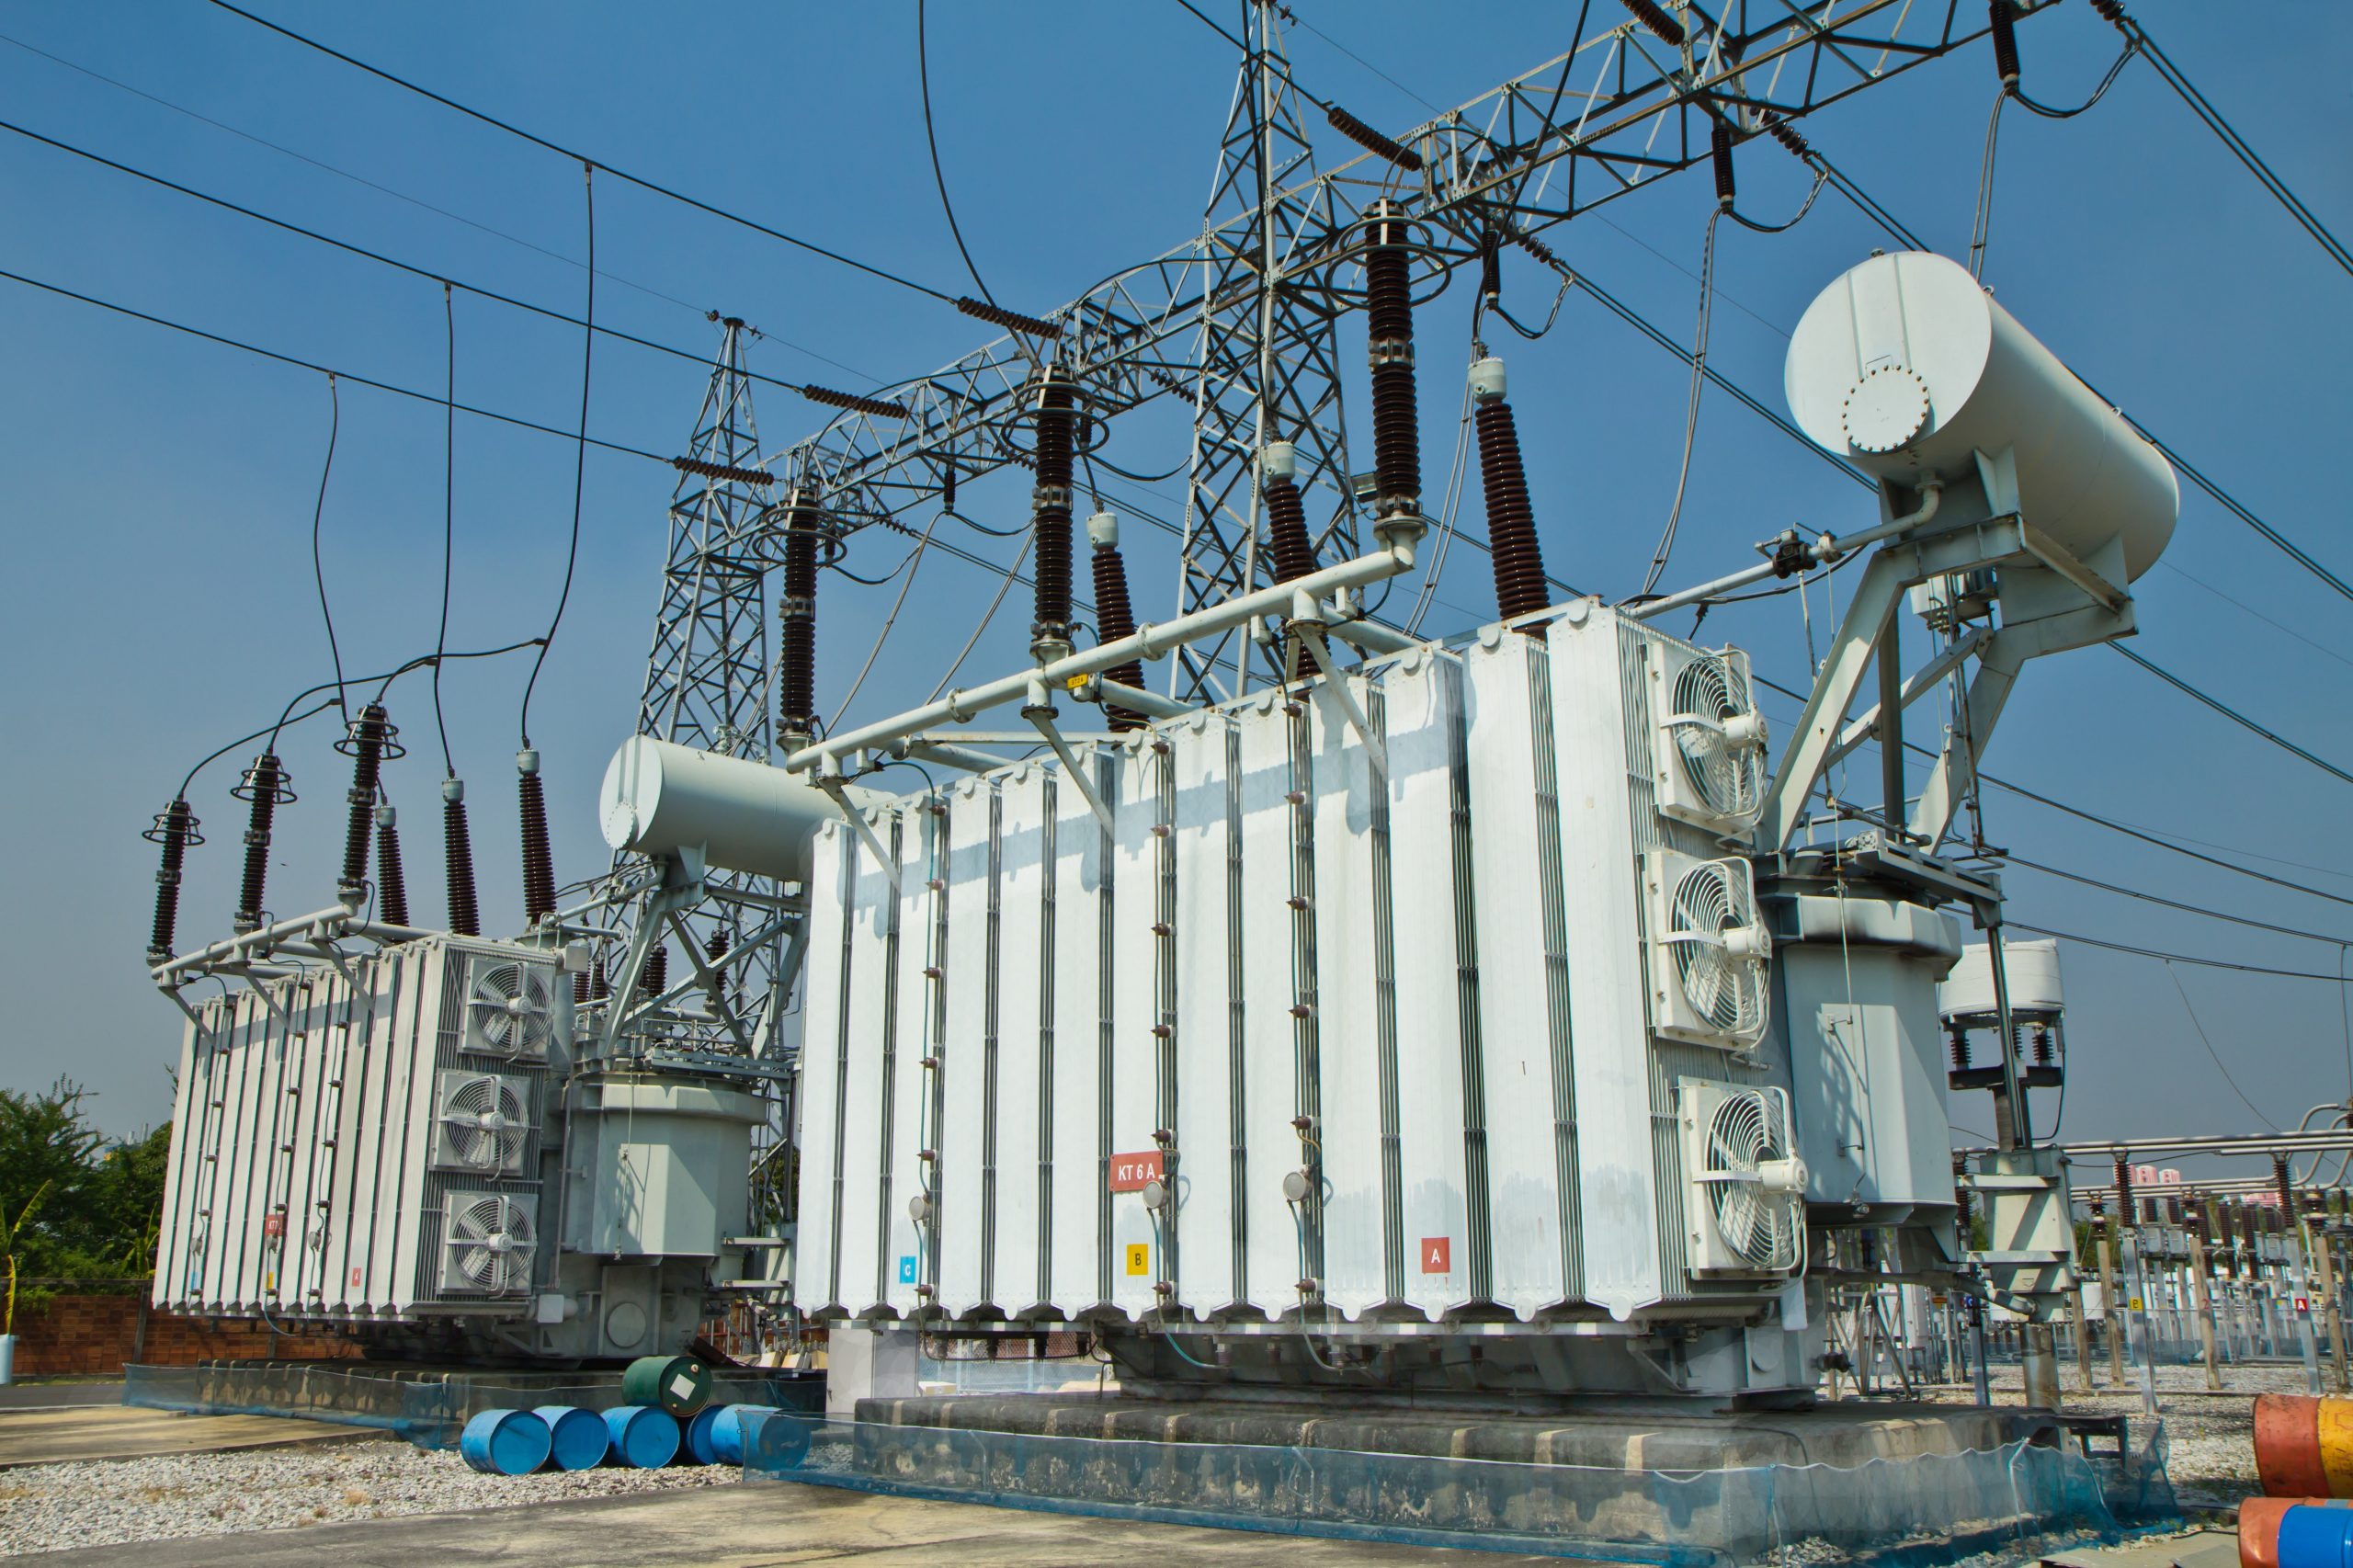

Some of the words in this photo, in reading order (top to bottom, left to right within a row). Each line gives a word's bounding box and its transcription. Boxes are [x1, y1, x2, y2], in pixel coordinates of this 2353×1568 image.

[1135, 1253, 1142, 1266] B
[1431, 1248, 1441, 1264] A
[904, 1265, 911, 1277] C
[2298, 1300, 2306, 1310] A
